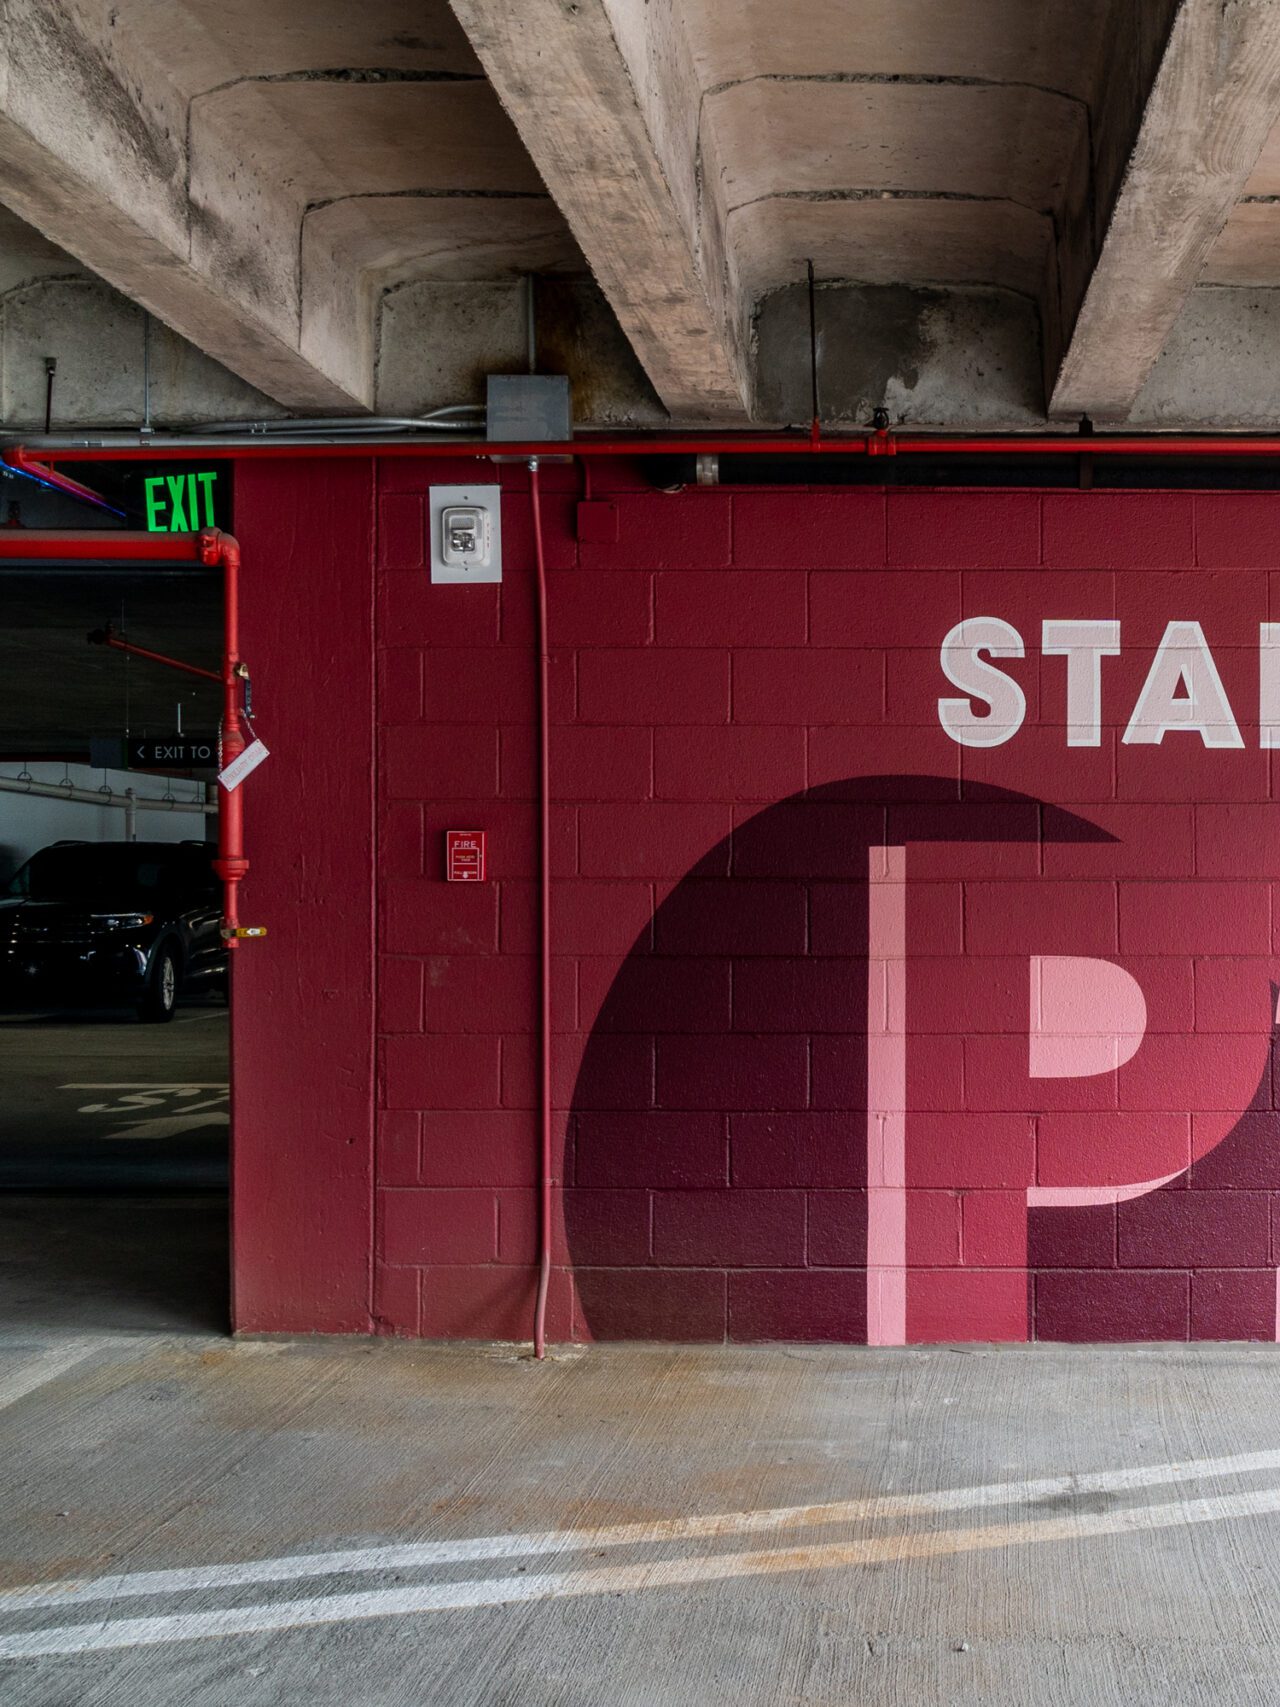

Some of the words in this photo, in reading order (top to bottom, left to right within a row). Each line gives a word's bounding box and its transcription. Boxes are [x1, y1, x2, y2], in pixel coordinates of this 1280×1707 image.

[145, 471, 217, 532] EXIT
[155, 745, 185, 759] EXIT
[190, 745, 211, 759] TO
[454, 840, 477, 849] FIRE
